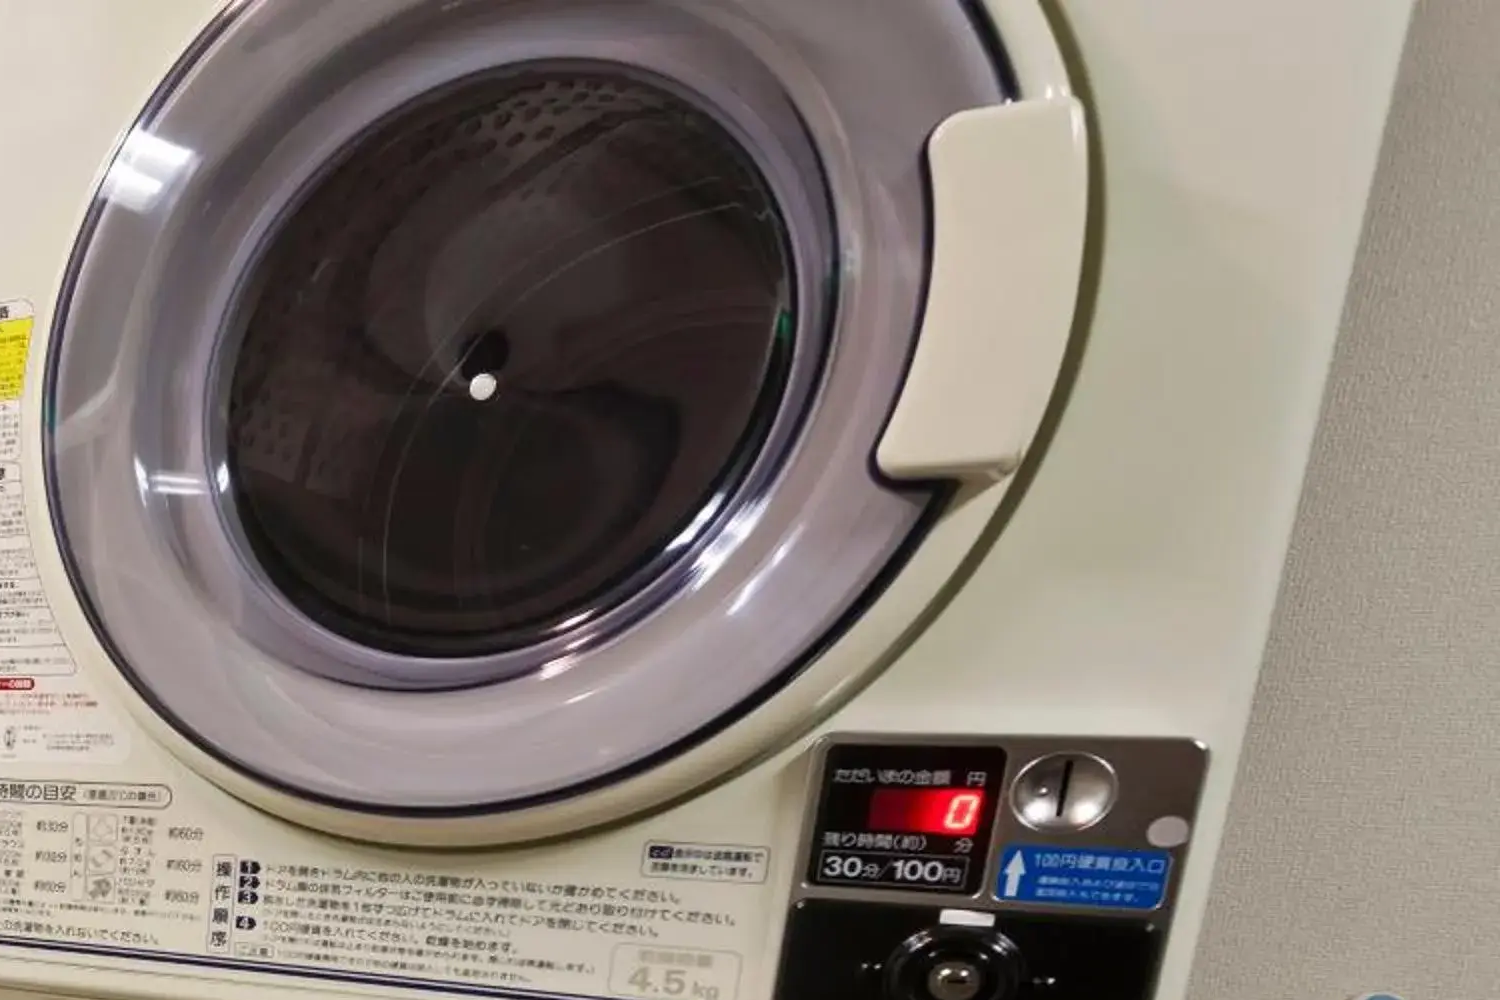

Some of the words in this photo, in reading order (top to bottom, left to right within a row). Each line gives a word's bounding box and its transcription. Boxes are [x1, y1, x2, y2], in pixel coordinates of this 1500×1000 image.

[834, 769, 951, 785] ただいまの金額
[966, 771, 987, 787] 円
[944, 795, 980, 829] 0
[953, 837, 974, 853] 分
